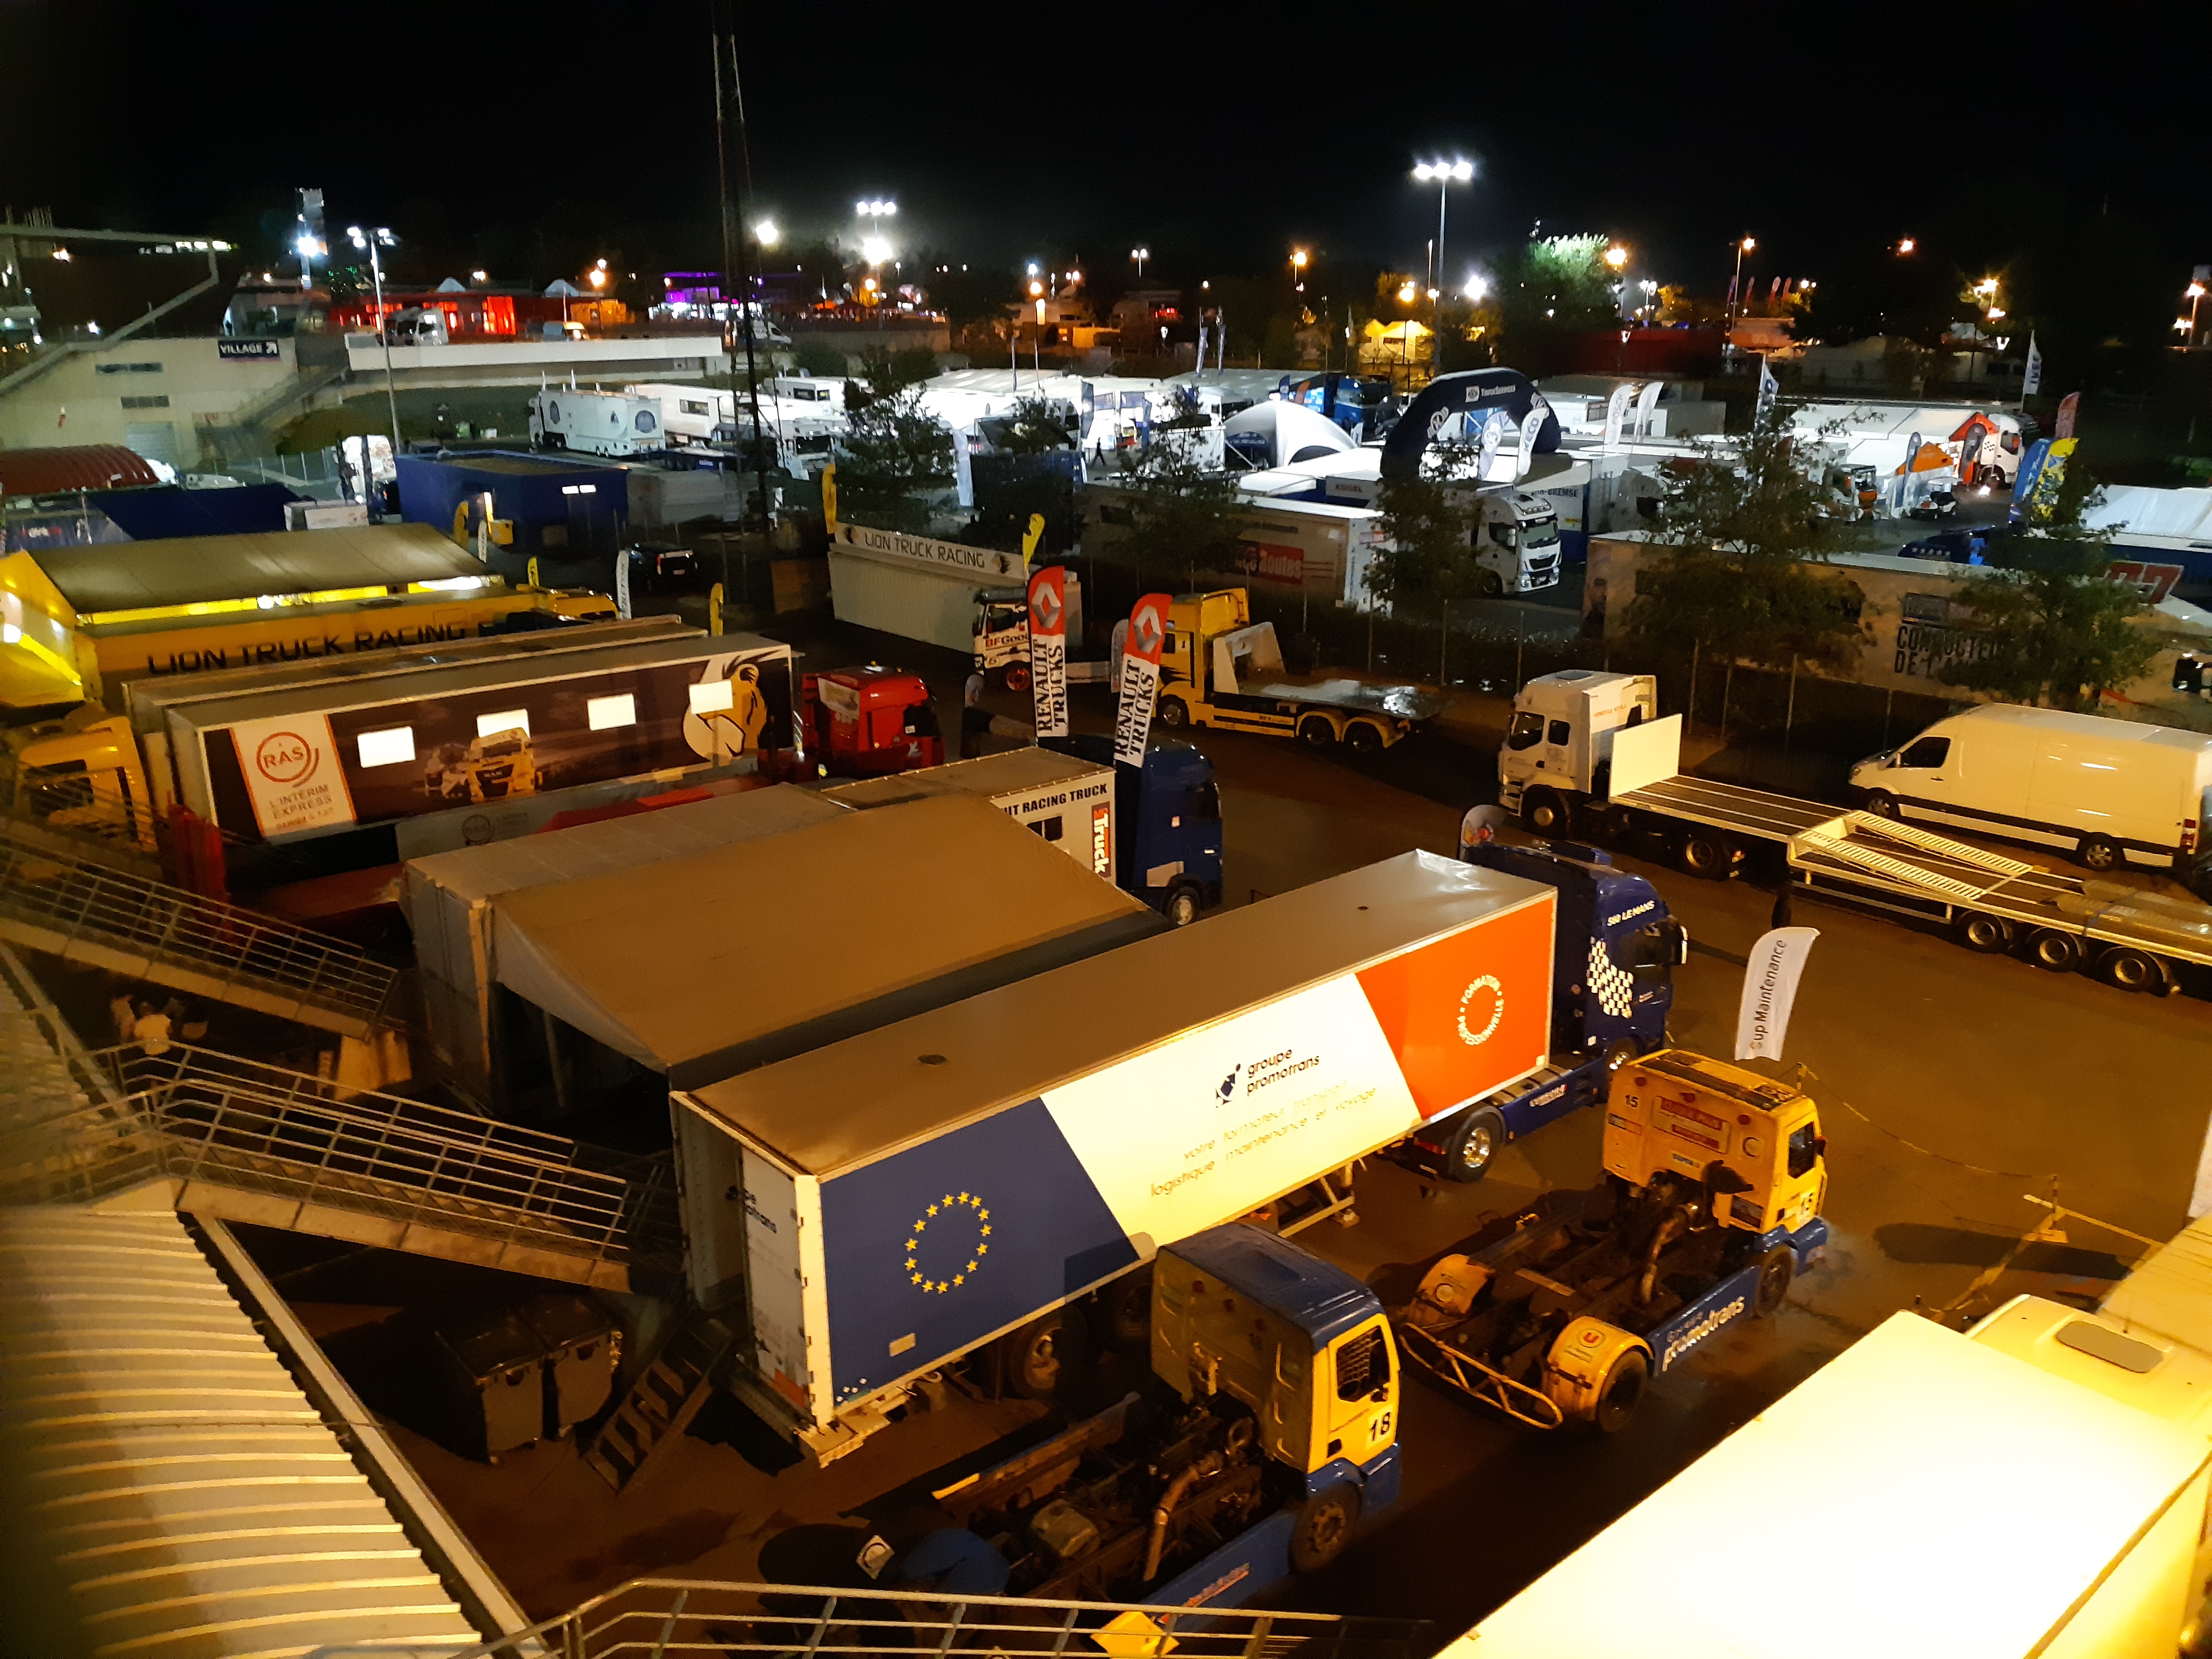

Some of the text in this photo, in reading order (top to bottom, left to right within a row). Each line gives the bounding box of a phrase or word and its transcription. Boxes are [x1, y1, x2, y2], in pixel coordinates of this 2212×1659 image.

[220, 343, 263, 354] VILLAGE
[865, 532, 985, 568] LION TRUCK RACING
[147, 624, 467, 674] LION TRUCK RACING
[1033, 639, 1053, 732] RENAULT
[1048, 645, 1066, 728] TRUCKS
[1114, 659, 1140, 757] RENAULT
[1129, 672, 1154, 756] TRUCKS
[263, 746, 305, 769] RAS
[272, 795, 333, 819] EXPRESS
[1023, 793, 1066, 814] RACING
[1070, 783, 1107, 802] TRUCK
[1094, 813, 1110, 874] Truck
[1754, 939, 1787, 1022] Maintenance
[1247, 1055, 1320, 1097] promotrans
[1248, 1049, 1292, 1079] groupe
[1625, 1094, 1638, 1108] 15
[1183, 1140, 1215, 1160] votre
[1151, 1160, 1215, 1197] logistique
[1369, 1411, 1392, 1442] 18
